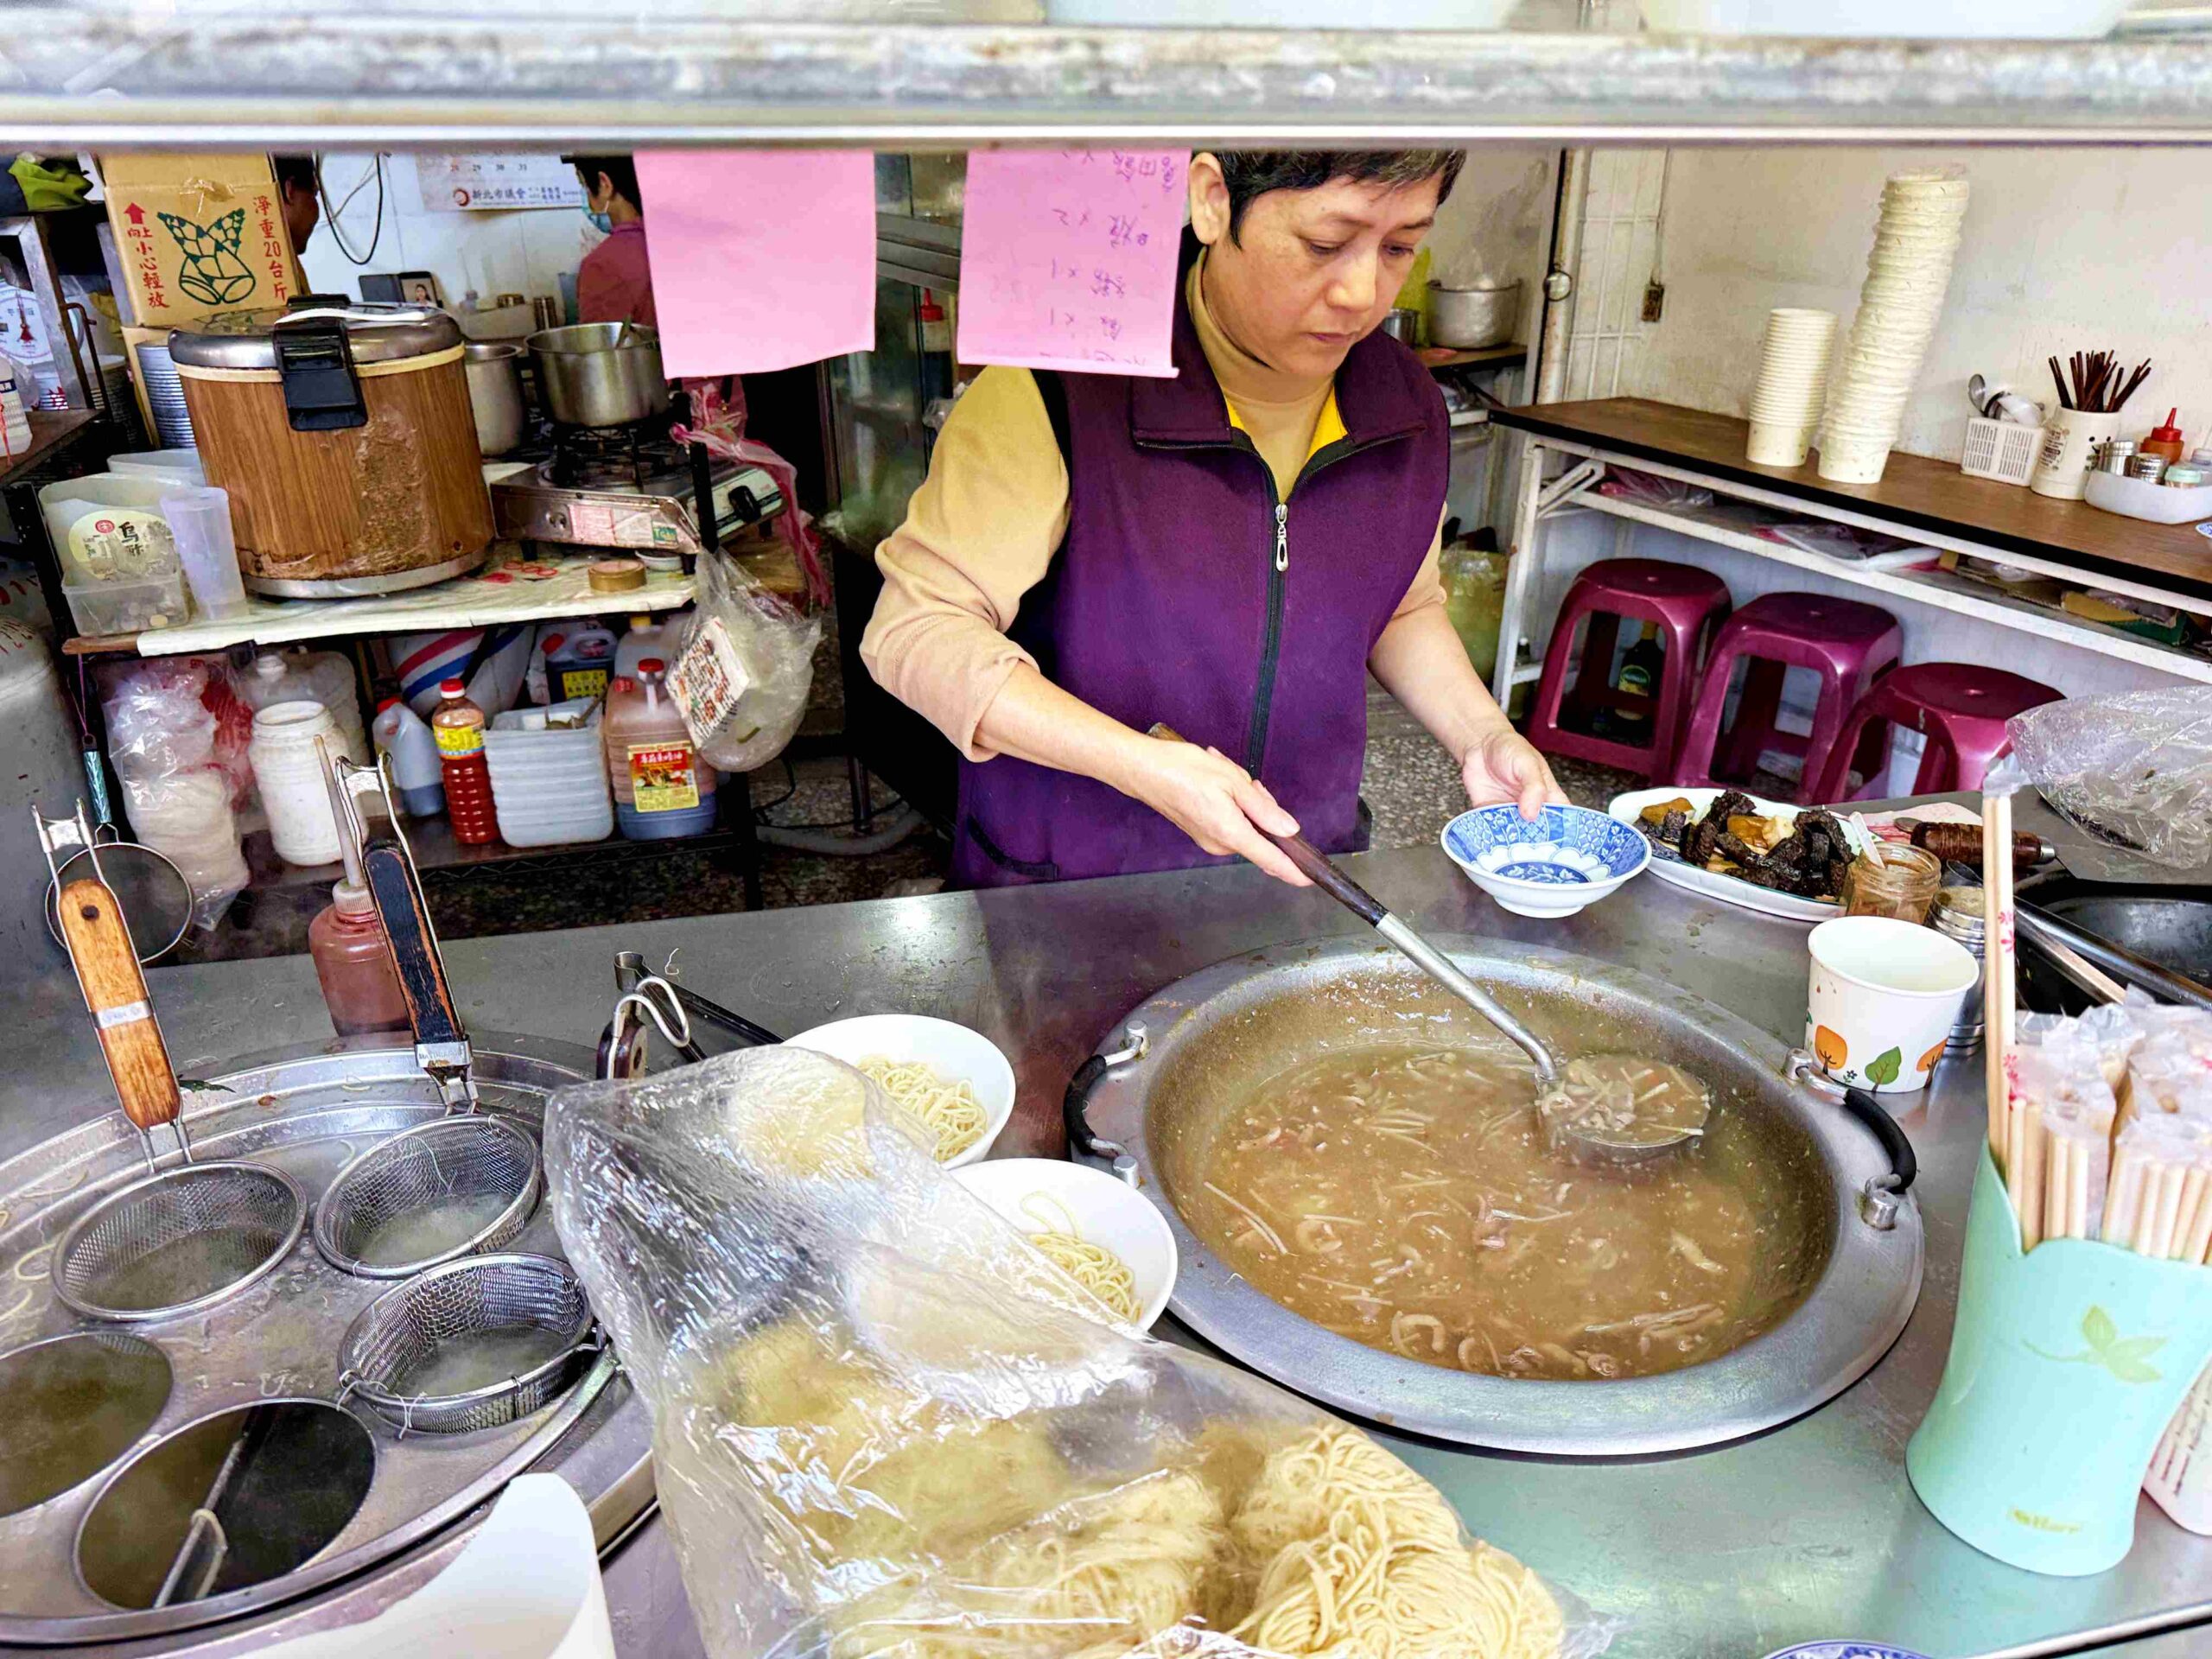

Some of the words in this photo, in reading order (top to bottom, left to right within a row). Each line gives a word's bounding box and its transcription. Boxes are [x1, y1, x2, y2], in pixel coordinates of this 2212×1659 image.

[127, 226, 153, 239] 向上
[252, 195, 288, 302] 淨重20台斤
[136, 241, 170, 308] 小心輕放
